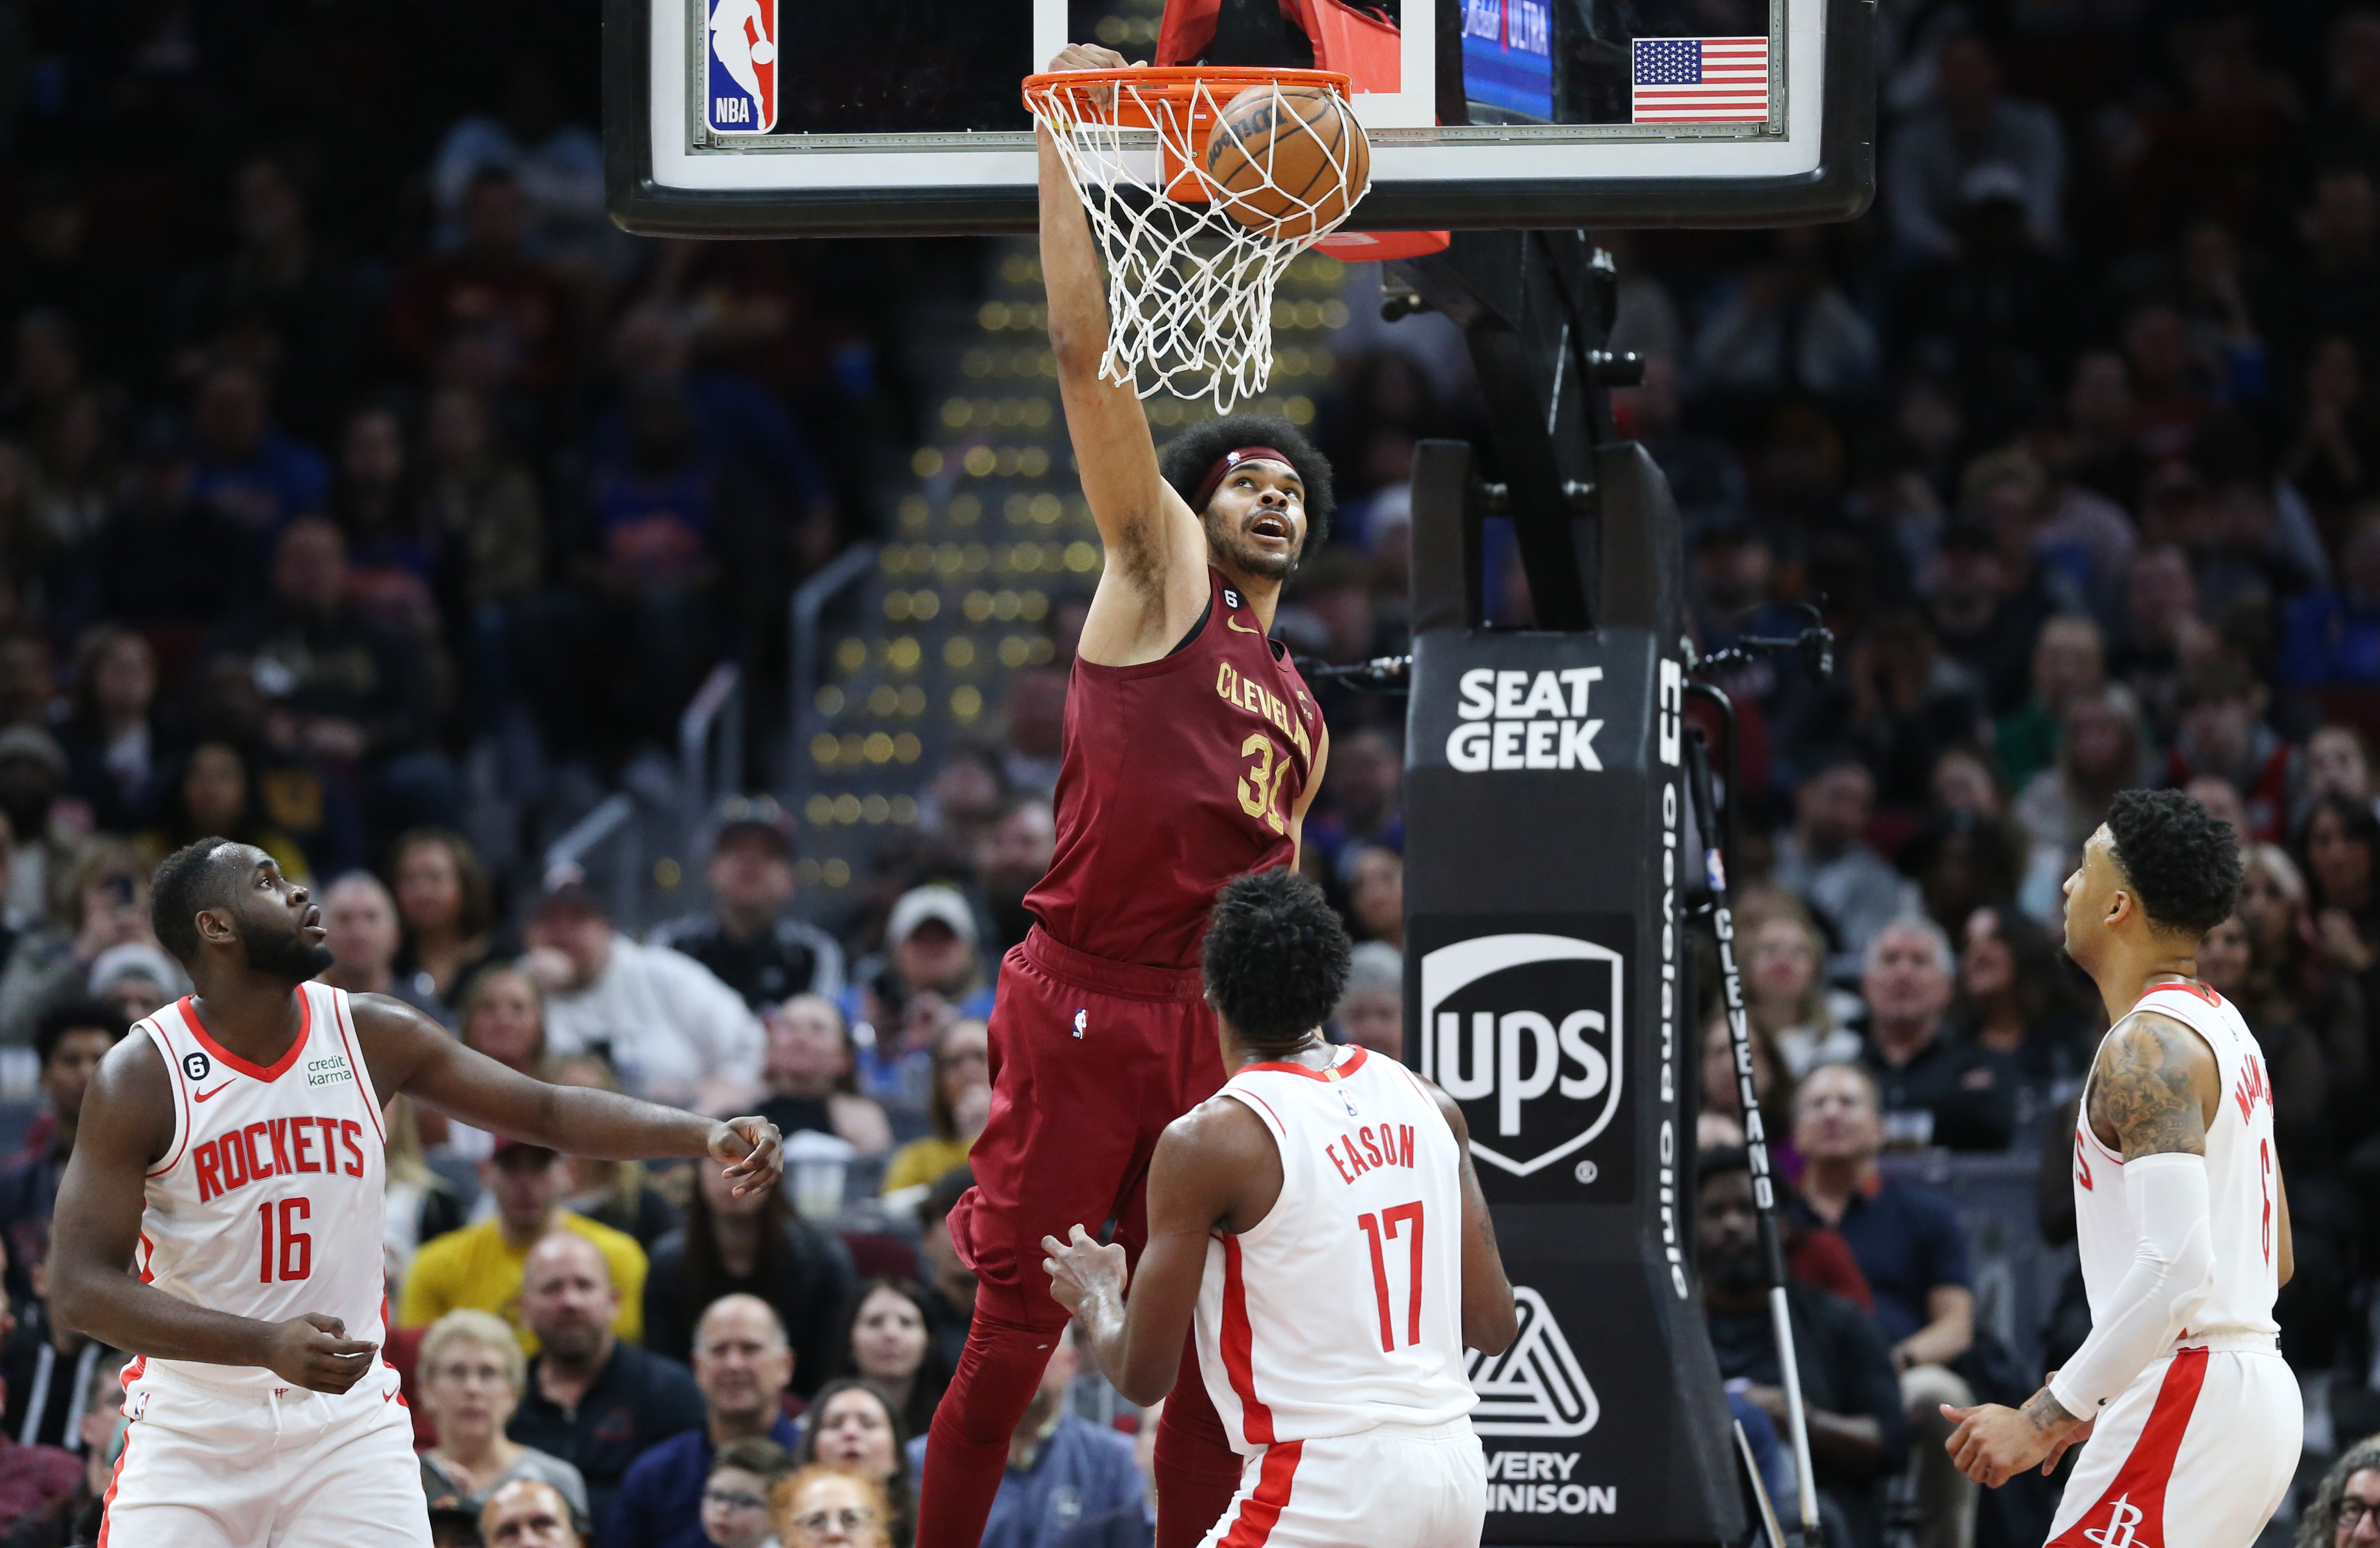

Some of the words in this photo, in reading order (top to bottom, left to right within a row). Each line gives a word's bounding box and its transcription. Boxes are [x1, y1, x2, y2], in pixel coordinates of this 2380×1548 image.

[716, 97, 750, 123] NBA
[1224, 590, 1238, 608] 6
[1458, 666, 1604, 720] SEAT
[1446, 719, 1605, 772] GEEK
[1661, 783, 1676, 1102] Cleveland
[188, 1056, 205, 1078] 6
[307, 1055, 346, 1072] credit
[307, 1068, 353, 1087] karma
[1437, 1009, 1608, 1136] ups
[1713, 907, 1774, 1210] CLEVELAND
[192, 1116, 364, 1204] ROCKETS
[1325, 1123, 1414, 1185] EASON
[1660, 1120, 1688, 1299] Clinic
[258, 1197, 311, 1284] 16
[1358, 1200, 1424, 1353] 17
[1484, 1451, 1581, 1481] VERY
[1485, 1483, 1617, 1514] NISON
